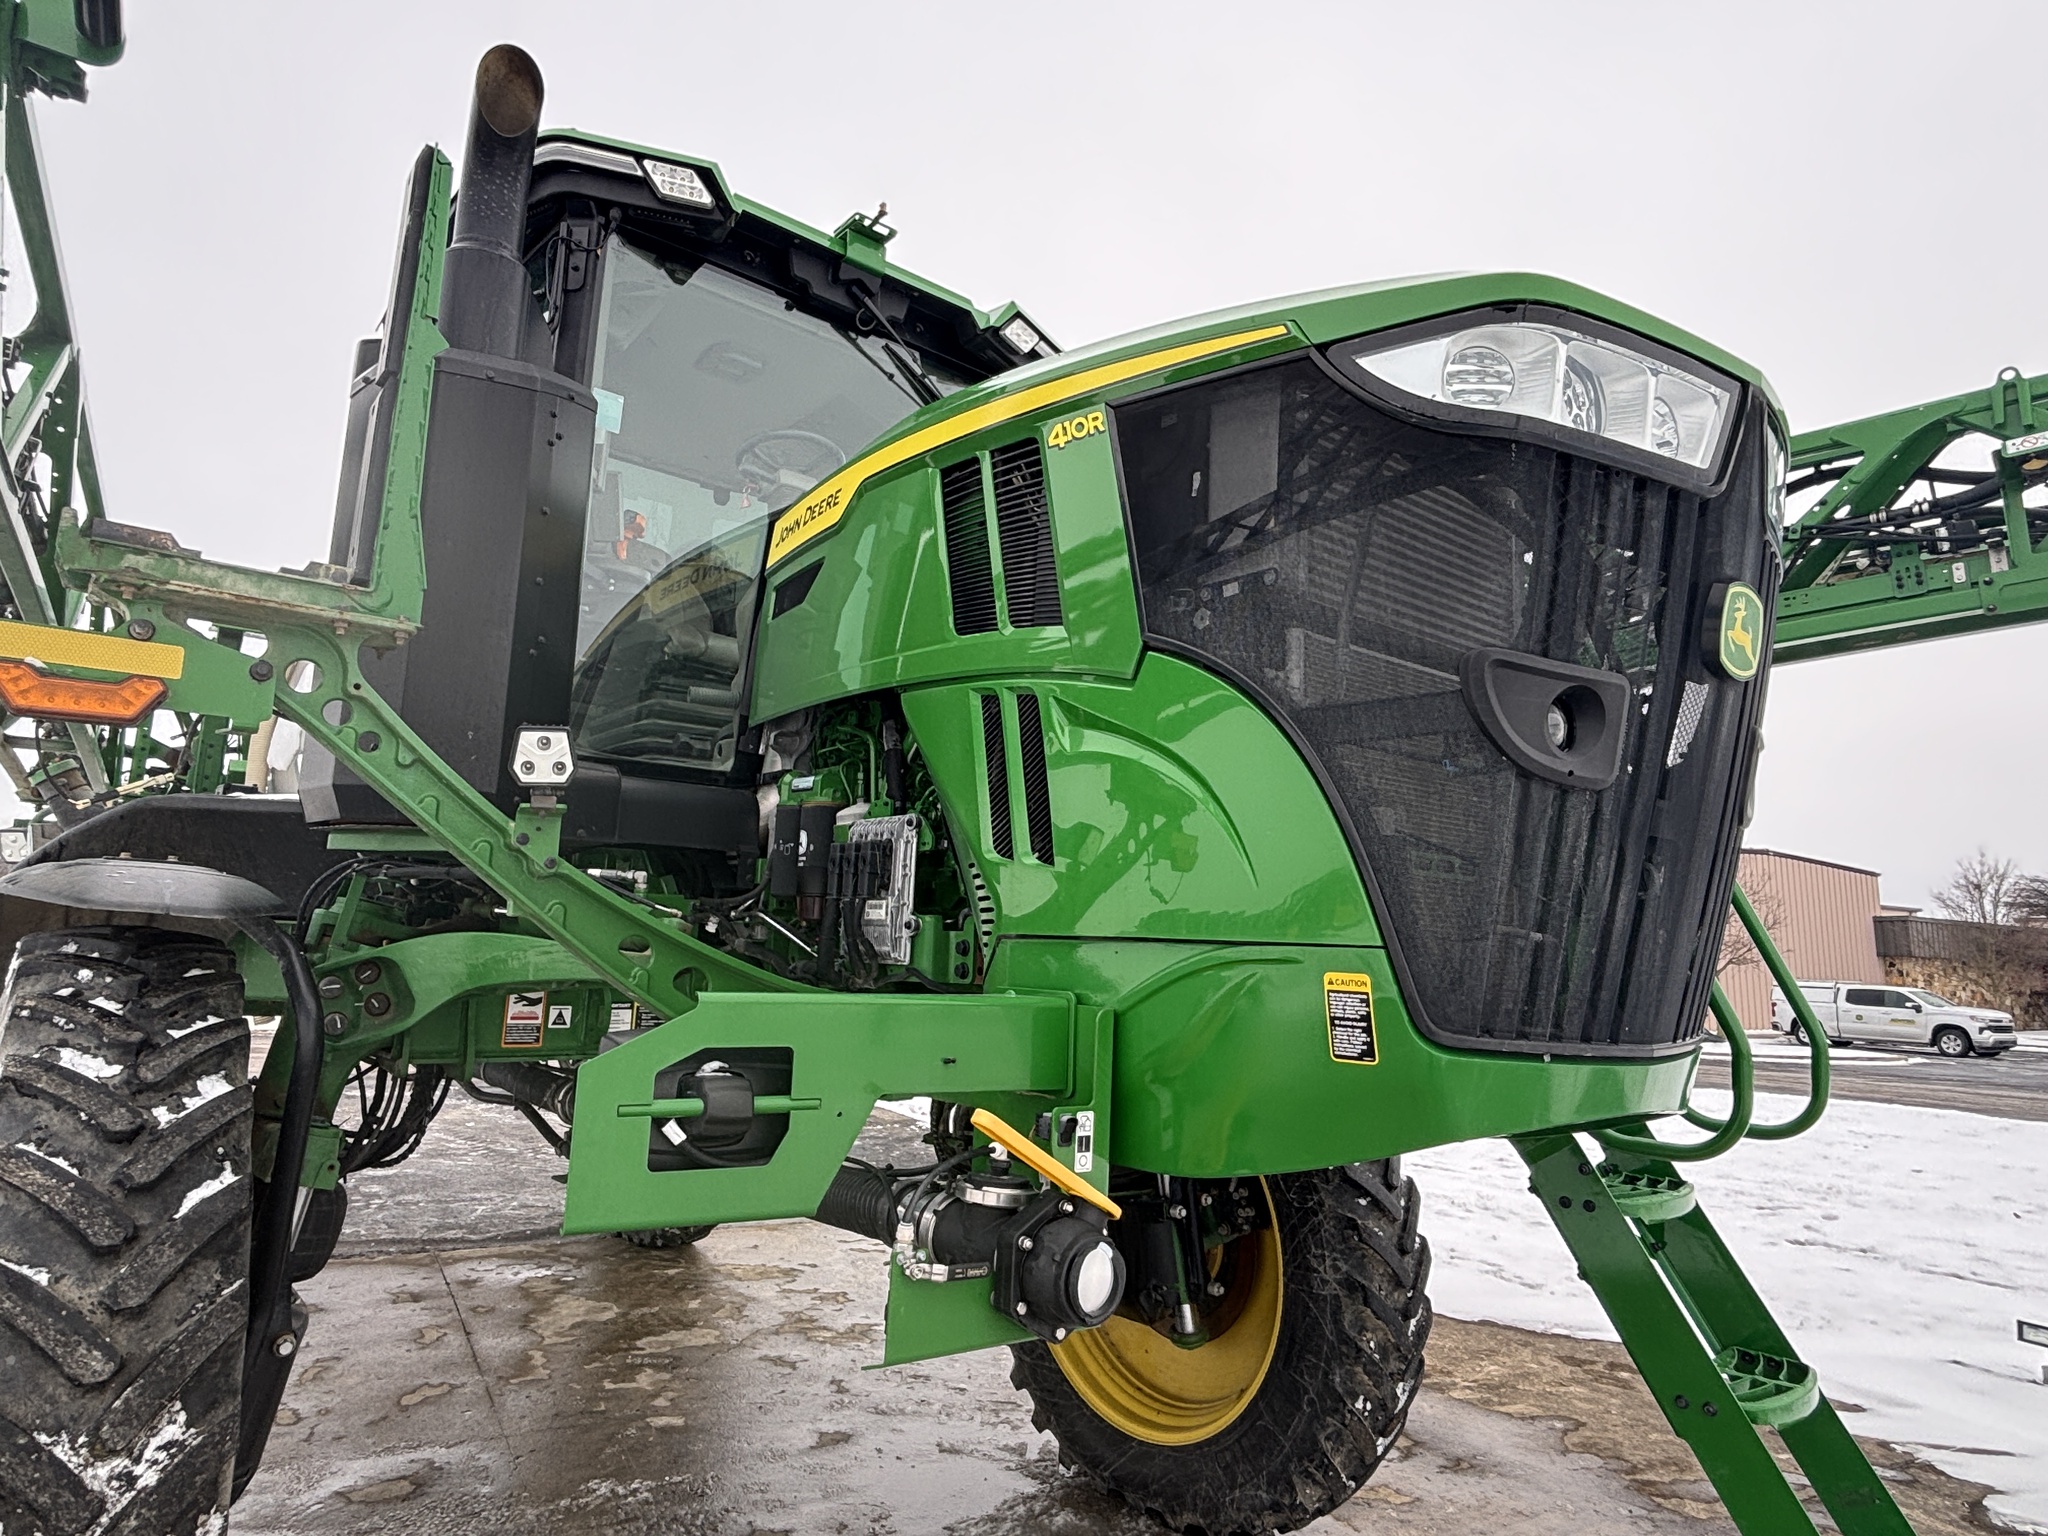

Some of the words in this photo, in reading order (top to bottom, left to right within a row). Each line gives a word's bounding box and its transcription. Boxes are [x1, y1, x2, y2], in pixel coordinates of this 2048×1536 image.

[1047, 411, 1106, 449] 410R
[775, 514, 803, 548] JOHN
[802, 488, 842, 527] DEERE
[1334, 978, 1368, 988] CAUTION
